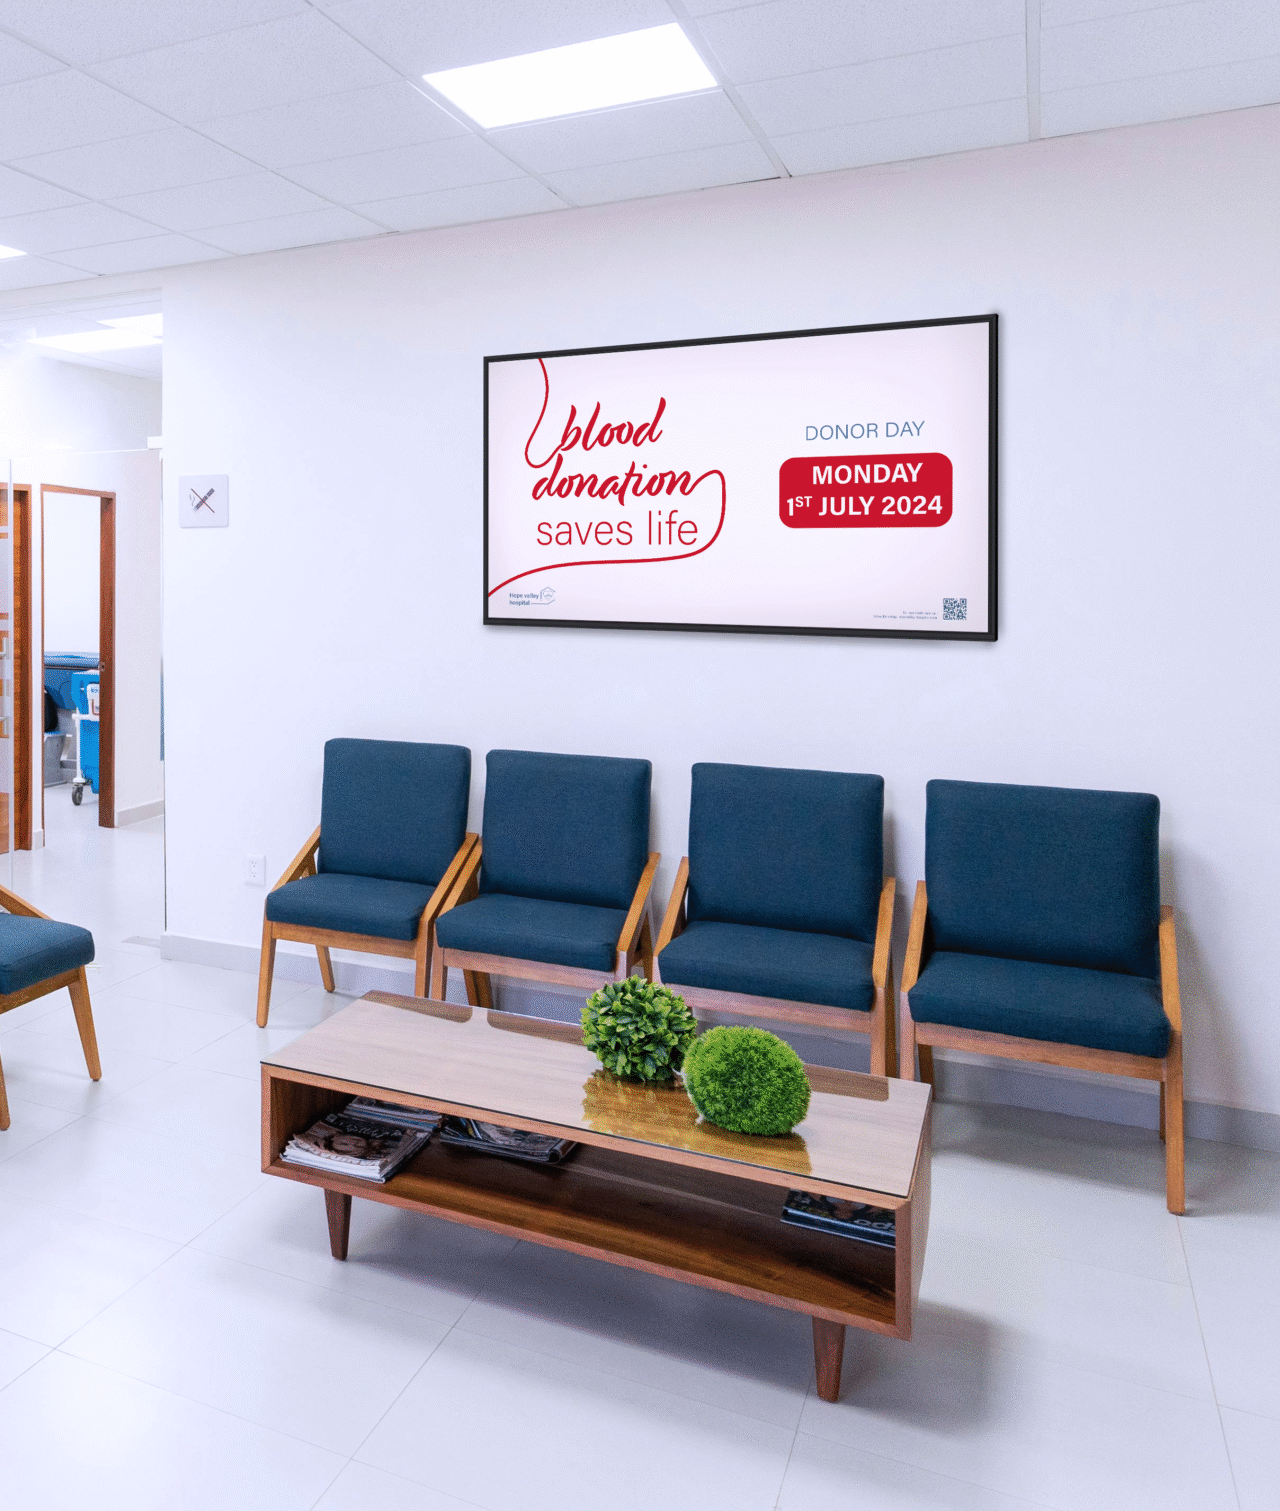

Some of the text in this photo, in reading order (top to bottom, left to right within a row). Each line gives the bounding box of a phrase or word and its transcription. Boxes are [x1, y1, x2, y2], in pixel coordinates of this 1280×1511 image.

[560, 396, 667, 452] blood
[805, 420, 926, 441] DONOR DAY
[531, 453, 694, 507] donation
[812, 462, 924, 486] MONDAY
[818, 496, 875, 518] JULY
[881, 494, 943, 516] 2024
[536, 509, 699, 547] saves life
